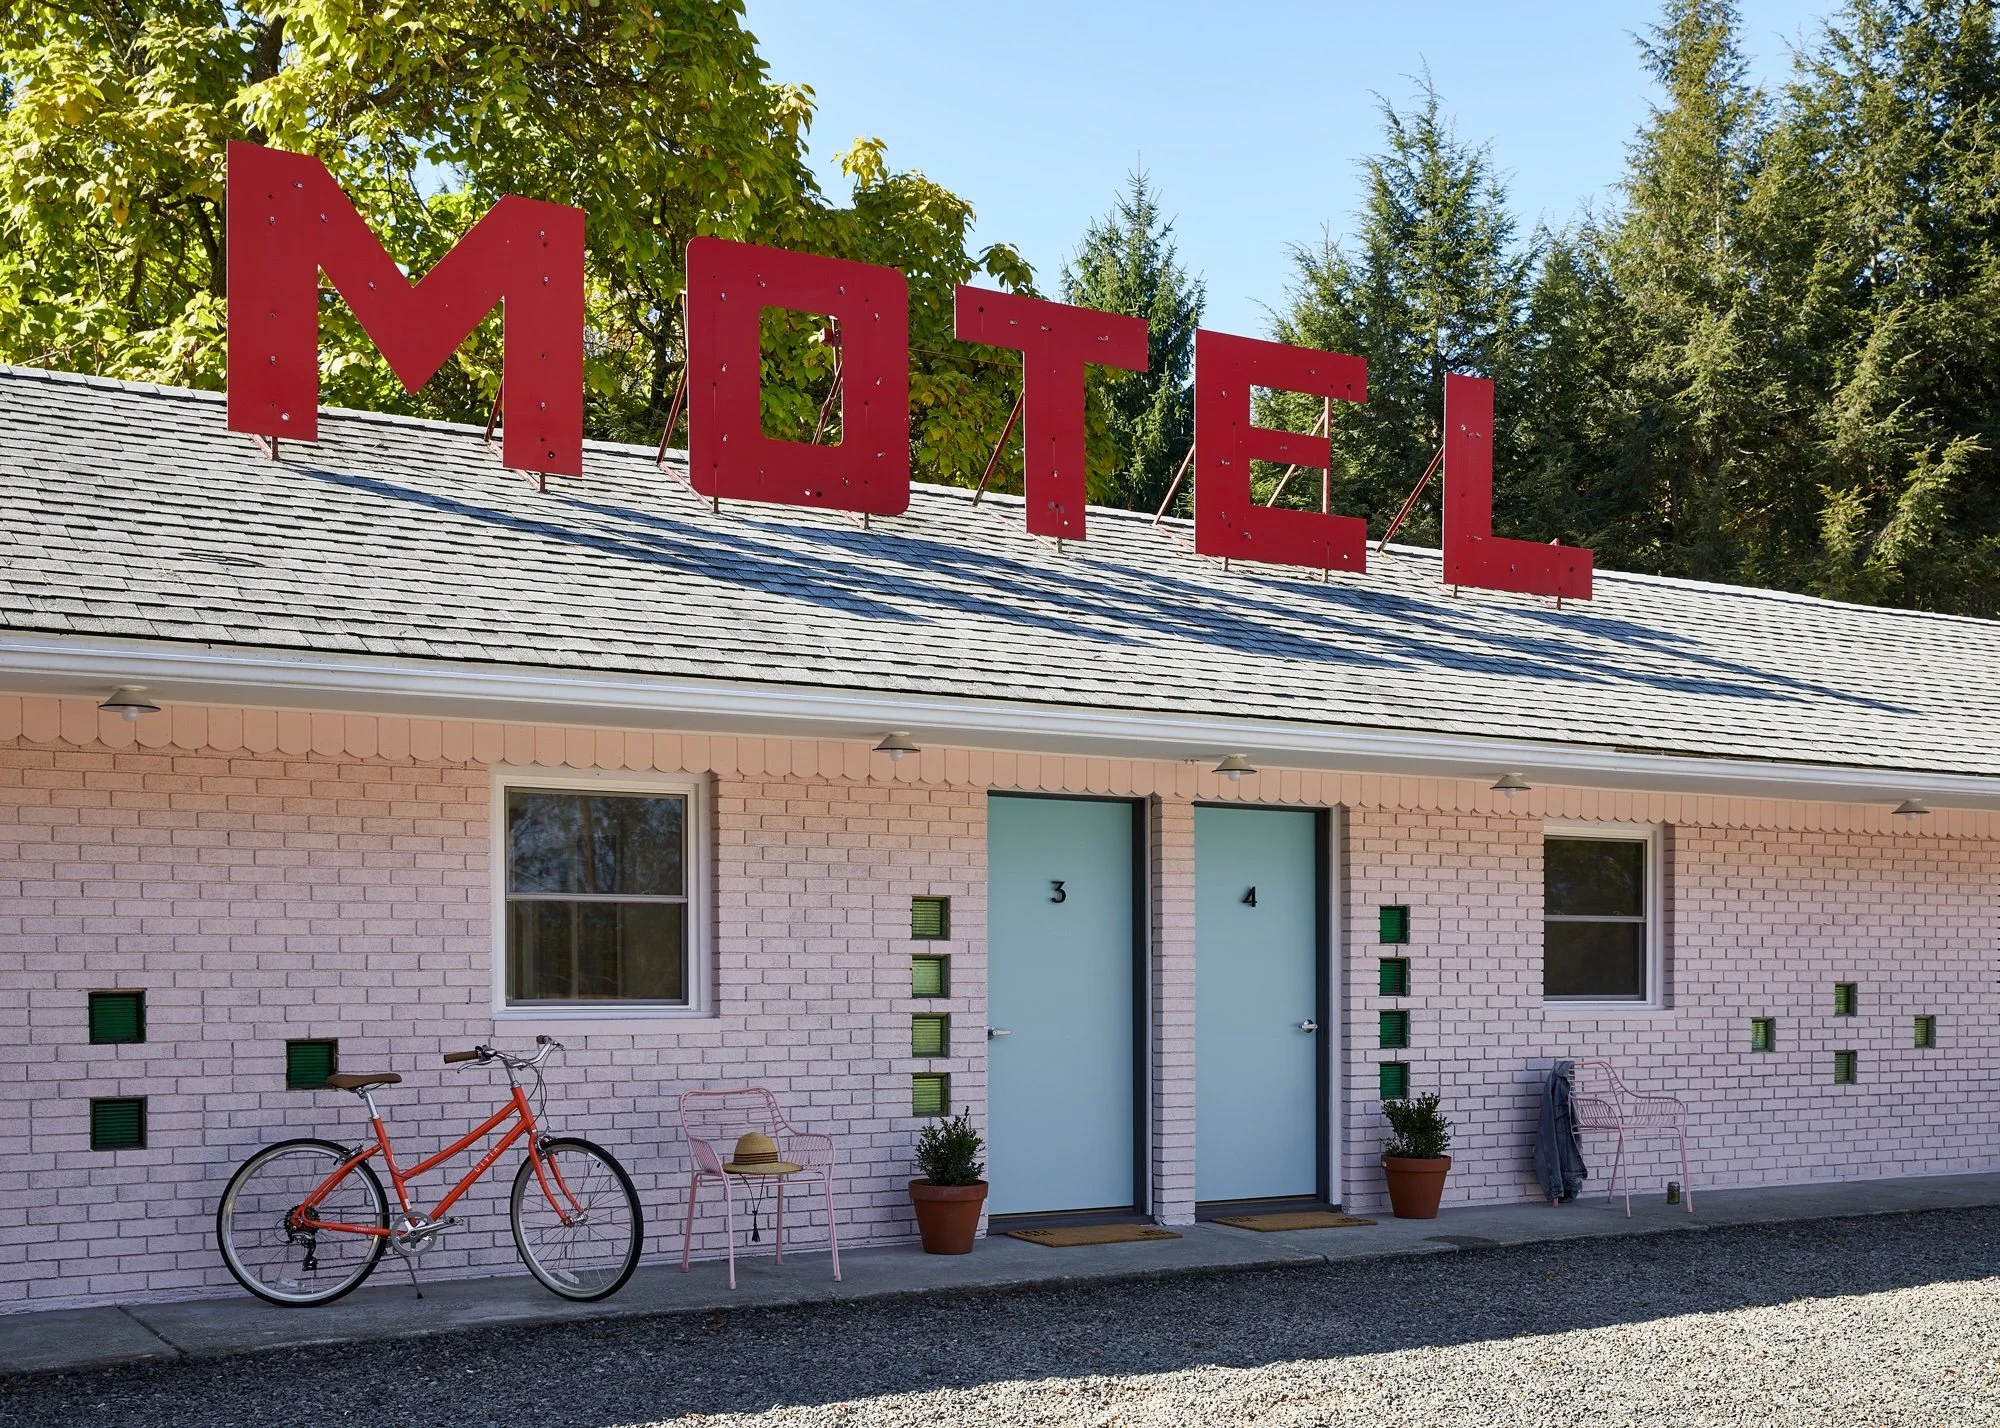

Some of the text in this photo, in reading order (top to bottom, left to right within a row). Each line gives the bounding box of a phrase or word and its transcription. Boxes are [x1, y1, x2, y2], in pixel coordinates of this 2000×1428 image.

[226, 139, 1594, 601] MOTEL
[1051, 880, 1066, 903] 3
[1242, 886, 1258, 907] 4
